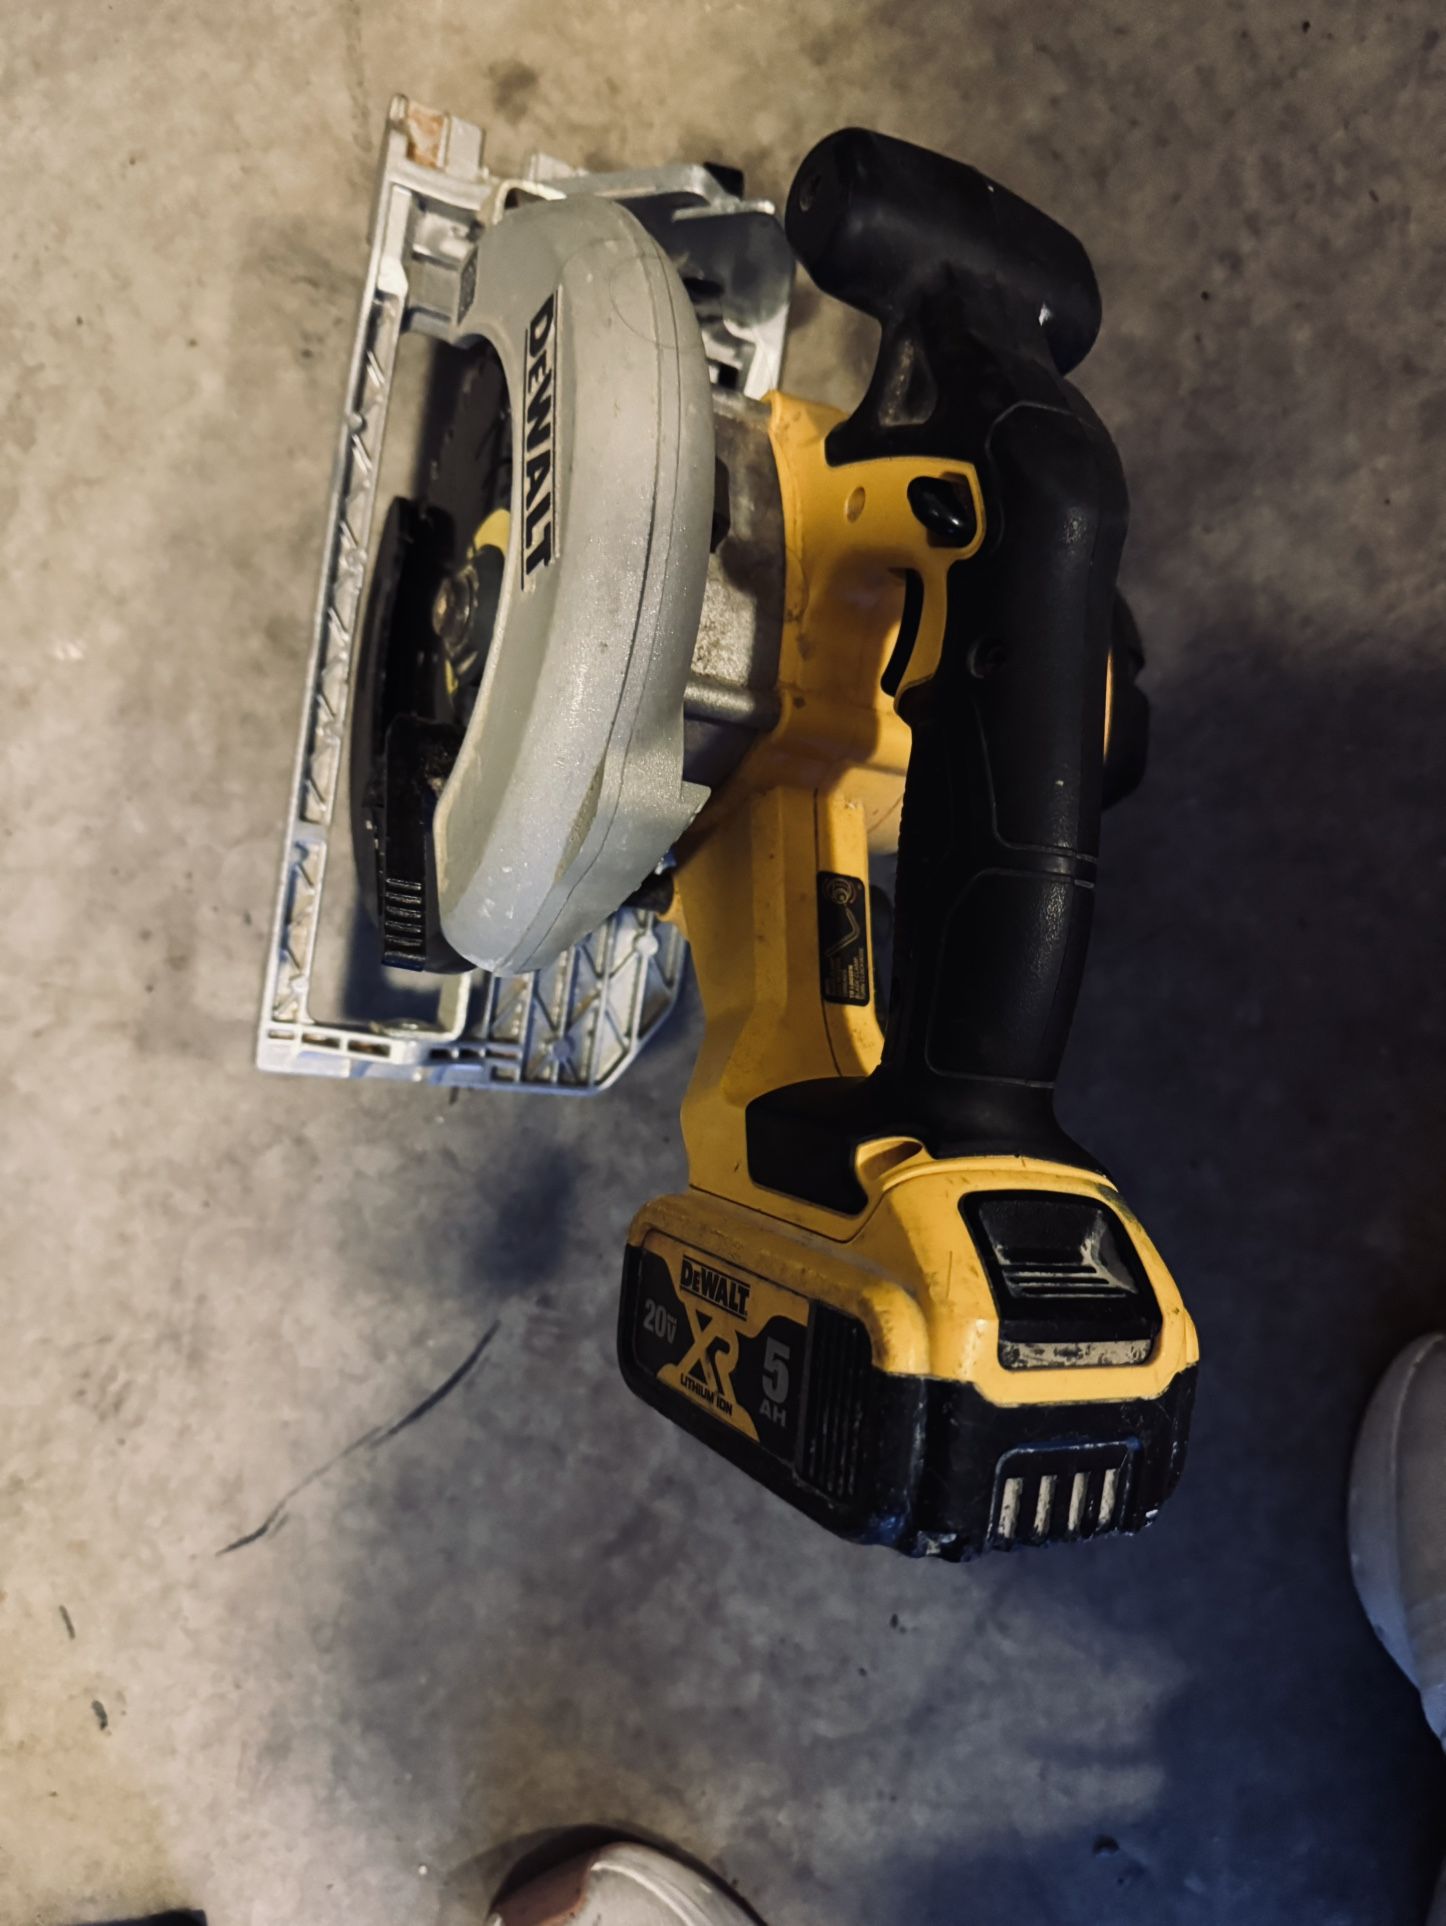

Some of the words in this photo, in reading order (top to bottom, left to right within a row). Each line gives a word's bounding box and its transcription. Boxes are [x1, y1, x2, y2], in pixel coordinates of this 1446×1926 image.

[526, 293, 555, 576] DEWALT
[680, 1258, 750, 1317] DEWALT
[643, 1298, 678, 1345] 20V
[659, 1303, 752, 1425] XR
[761, 1336, 791, 1404] 5
[680, 1373, 714, 1404] LITHIUM
[716, 1396, 733, 1416] ION
[759, 1400, 787, 1428] AH
